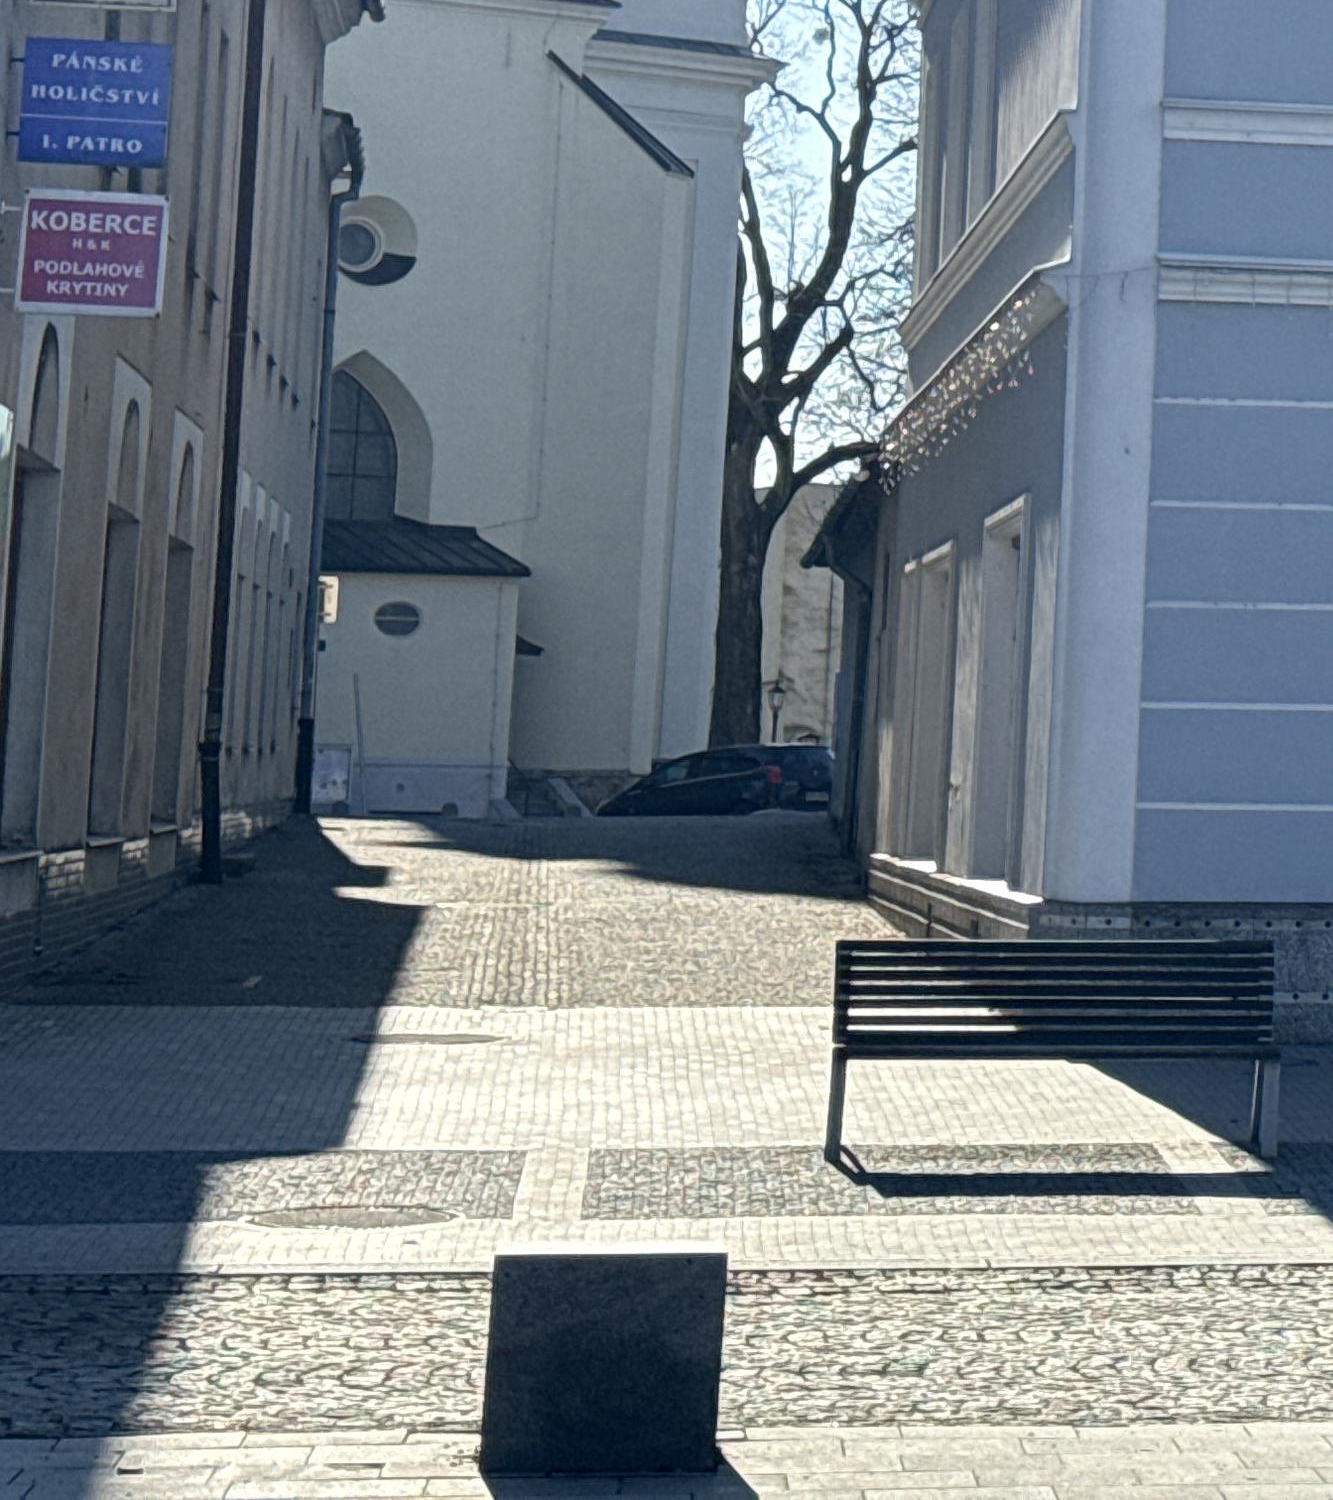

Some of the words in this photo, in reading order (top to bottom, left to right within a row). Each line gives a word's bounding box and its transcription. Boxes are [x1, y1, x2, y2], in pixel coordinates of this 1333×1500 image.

[51, 51, 144, 73] PÁNSKÉ
[31, 84, 160, 106] HOLIČSTVÍ
[66, 135, 143, 154] PATRO
[30, 210, 158, 237] KOBERCE
[72, 238, 83, 250] H
[33, 259, 145, 279] PODLAHOVÉ
[46, 280, 130, 297] KRYTINY
